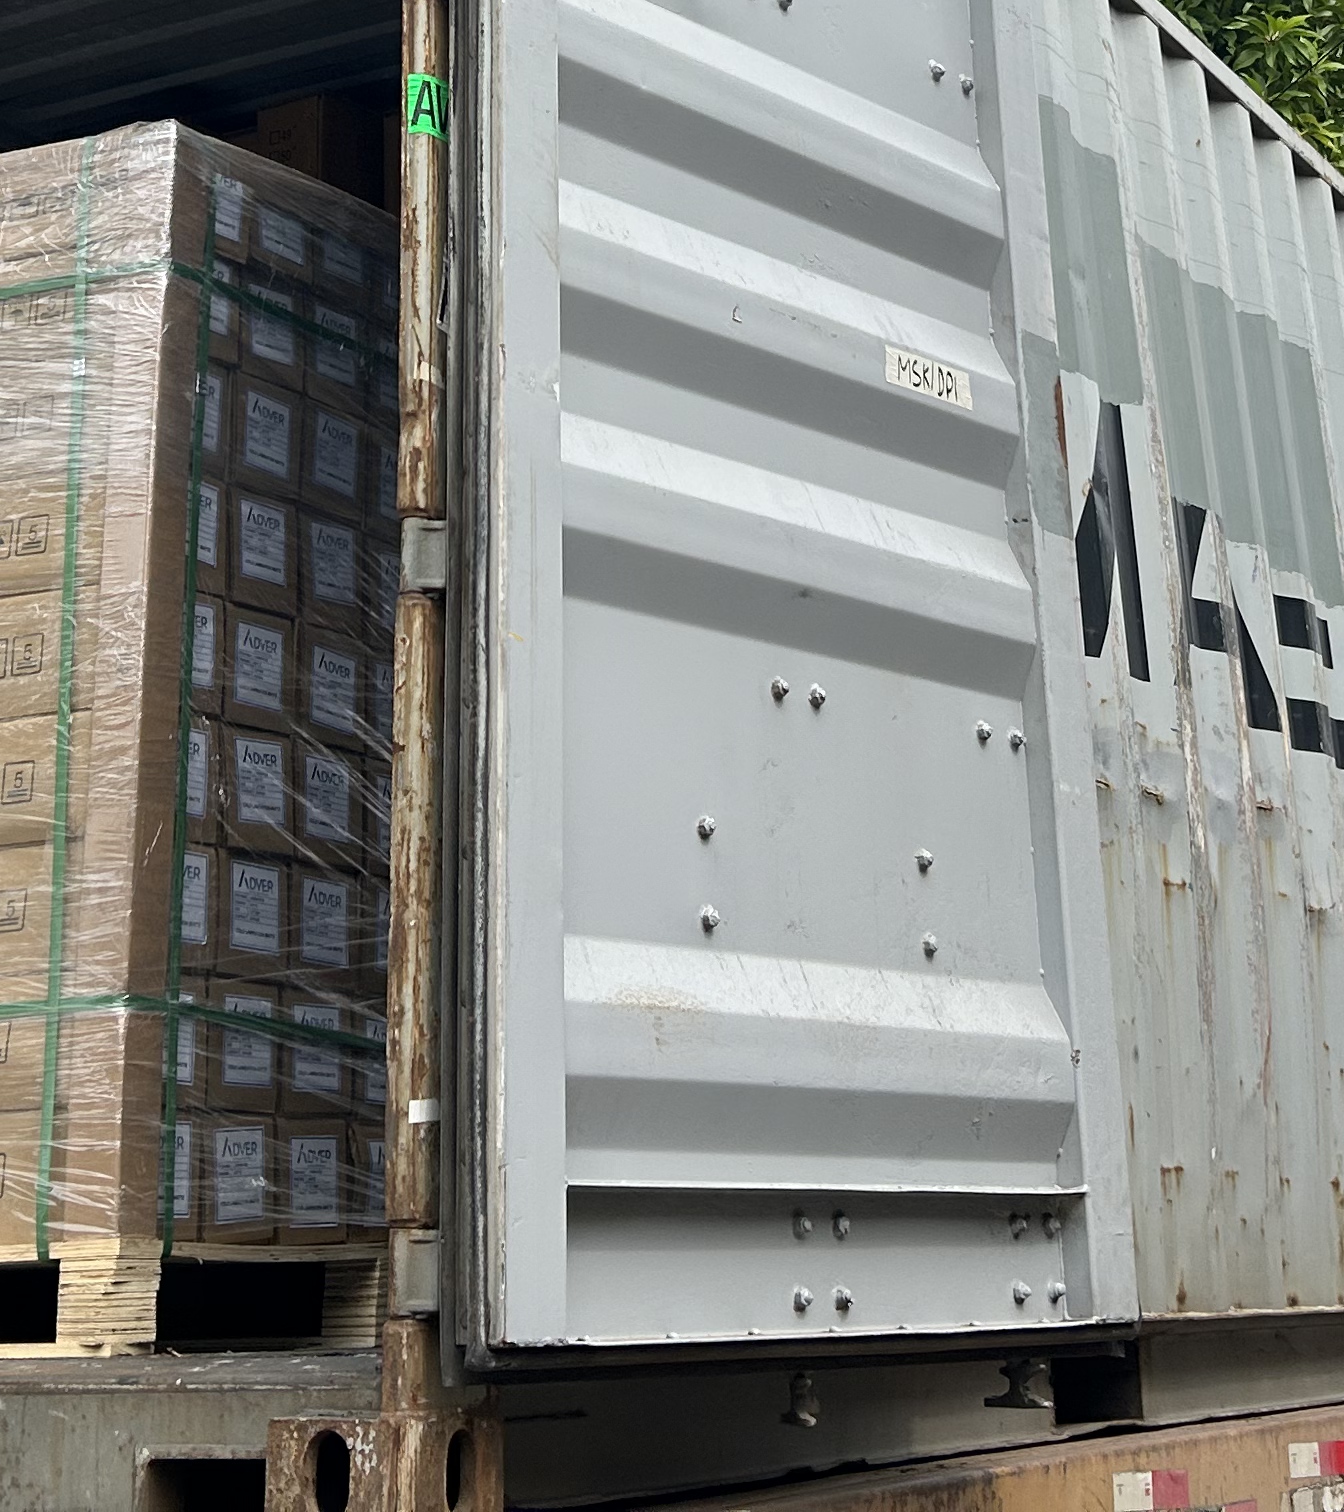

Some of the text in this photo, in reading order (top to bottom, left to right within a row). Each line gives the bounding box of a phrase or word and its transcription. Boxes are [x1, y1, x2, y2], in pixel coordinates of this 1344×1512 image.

[246, 505, 281, 531] ADVER
[316, 527, 350, 552] ADVER
[242, 628, 278, 655] ADVER
[318, 651, 351, 680] ADVER
[242, 744, 278, 768] ADVER
[14, 770, 24, 789] 5
[238, 868, 274, 894] ADVER
[308, 884, 342, 909] ADVER
[222, 1136, 258, 1158] ADVER
[297, 1143, 332, 1165] ADVER
